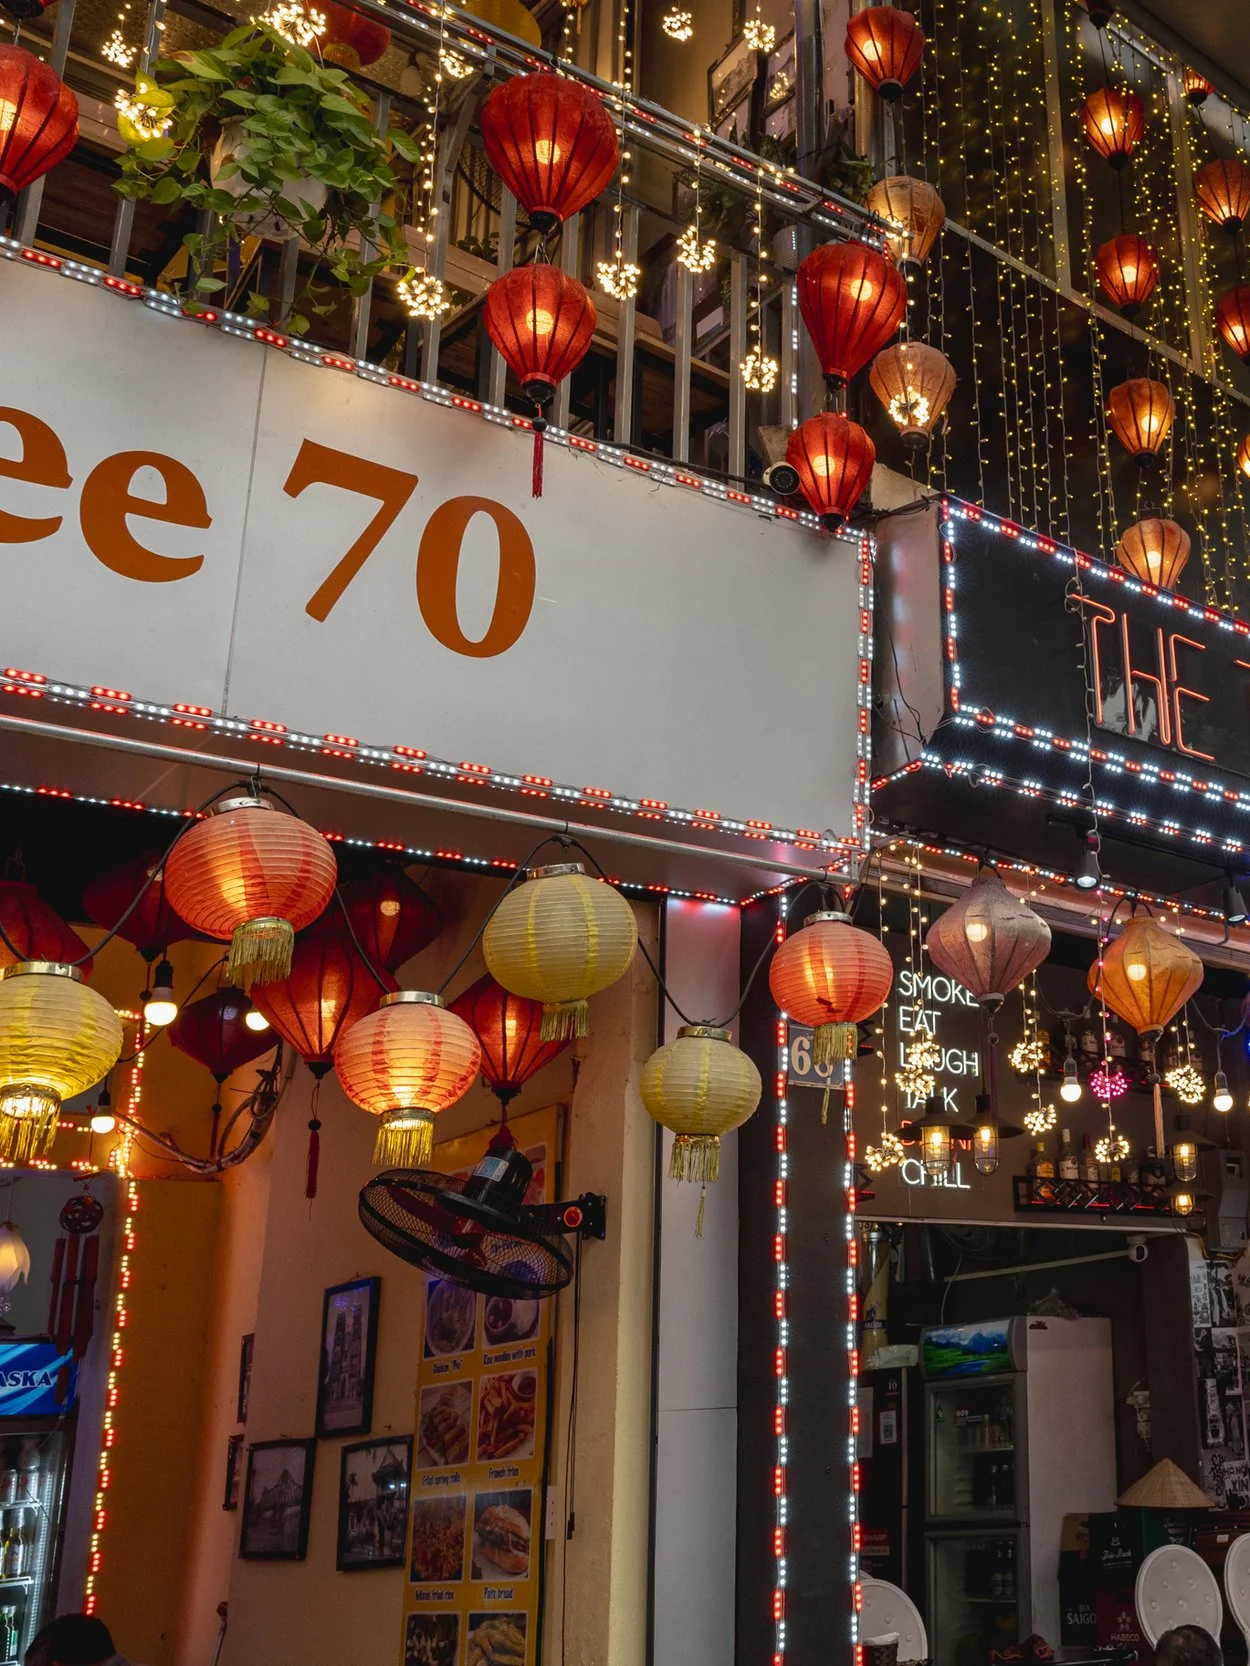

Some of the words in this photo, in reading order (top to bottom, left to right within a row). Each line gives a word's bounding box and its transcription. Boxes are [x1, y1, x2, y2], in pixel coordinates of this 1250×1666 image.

[283, 438, 537, 658] 70
[1069, 593, 1216, 762] THE
[900, 1006, 941, 1035] EAT
[1110, 1633, 1140, 1642] HABECO
